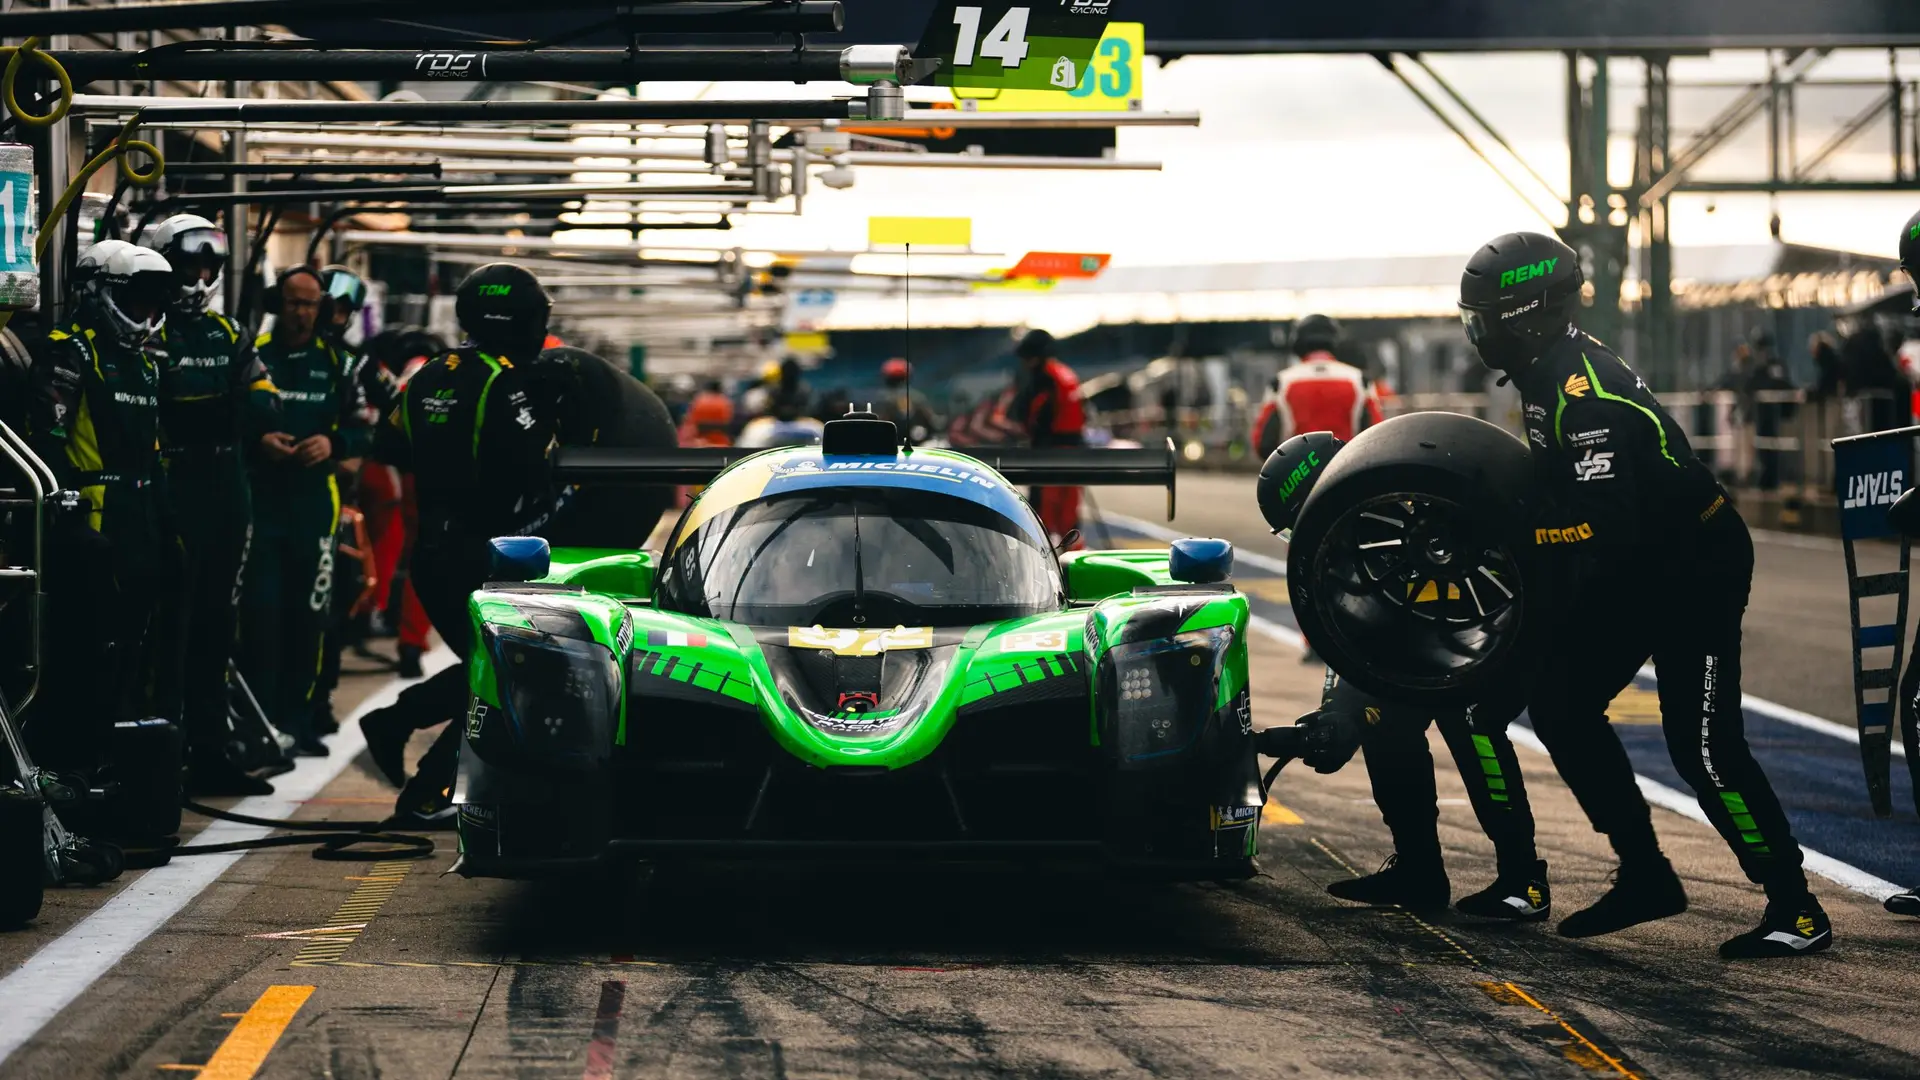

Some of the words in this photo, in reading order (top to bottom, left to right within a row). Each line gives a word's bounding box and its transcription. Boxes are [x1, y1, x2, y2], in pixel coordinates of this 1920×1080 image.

[1069, 7, 1108, 15] RACING
[952, 6, 1030, 67] 14
[416, 53, 476, 70] TDS
[1500, 257, 1557, 289] REMY
[478, 284, 513, 296] TOM
[1577, 428, 1610, 438] MICHELIN
[828, 462, 996, 489] MICHELIN
[1279, 460, 1311, 504] AURE
[1308, 450, 1320, 467] C
[1843, 470, 1904, 509] START
[1005, 631, 1063, 649] P3
[1702, 655, 1713, 712] RACING
